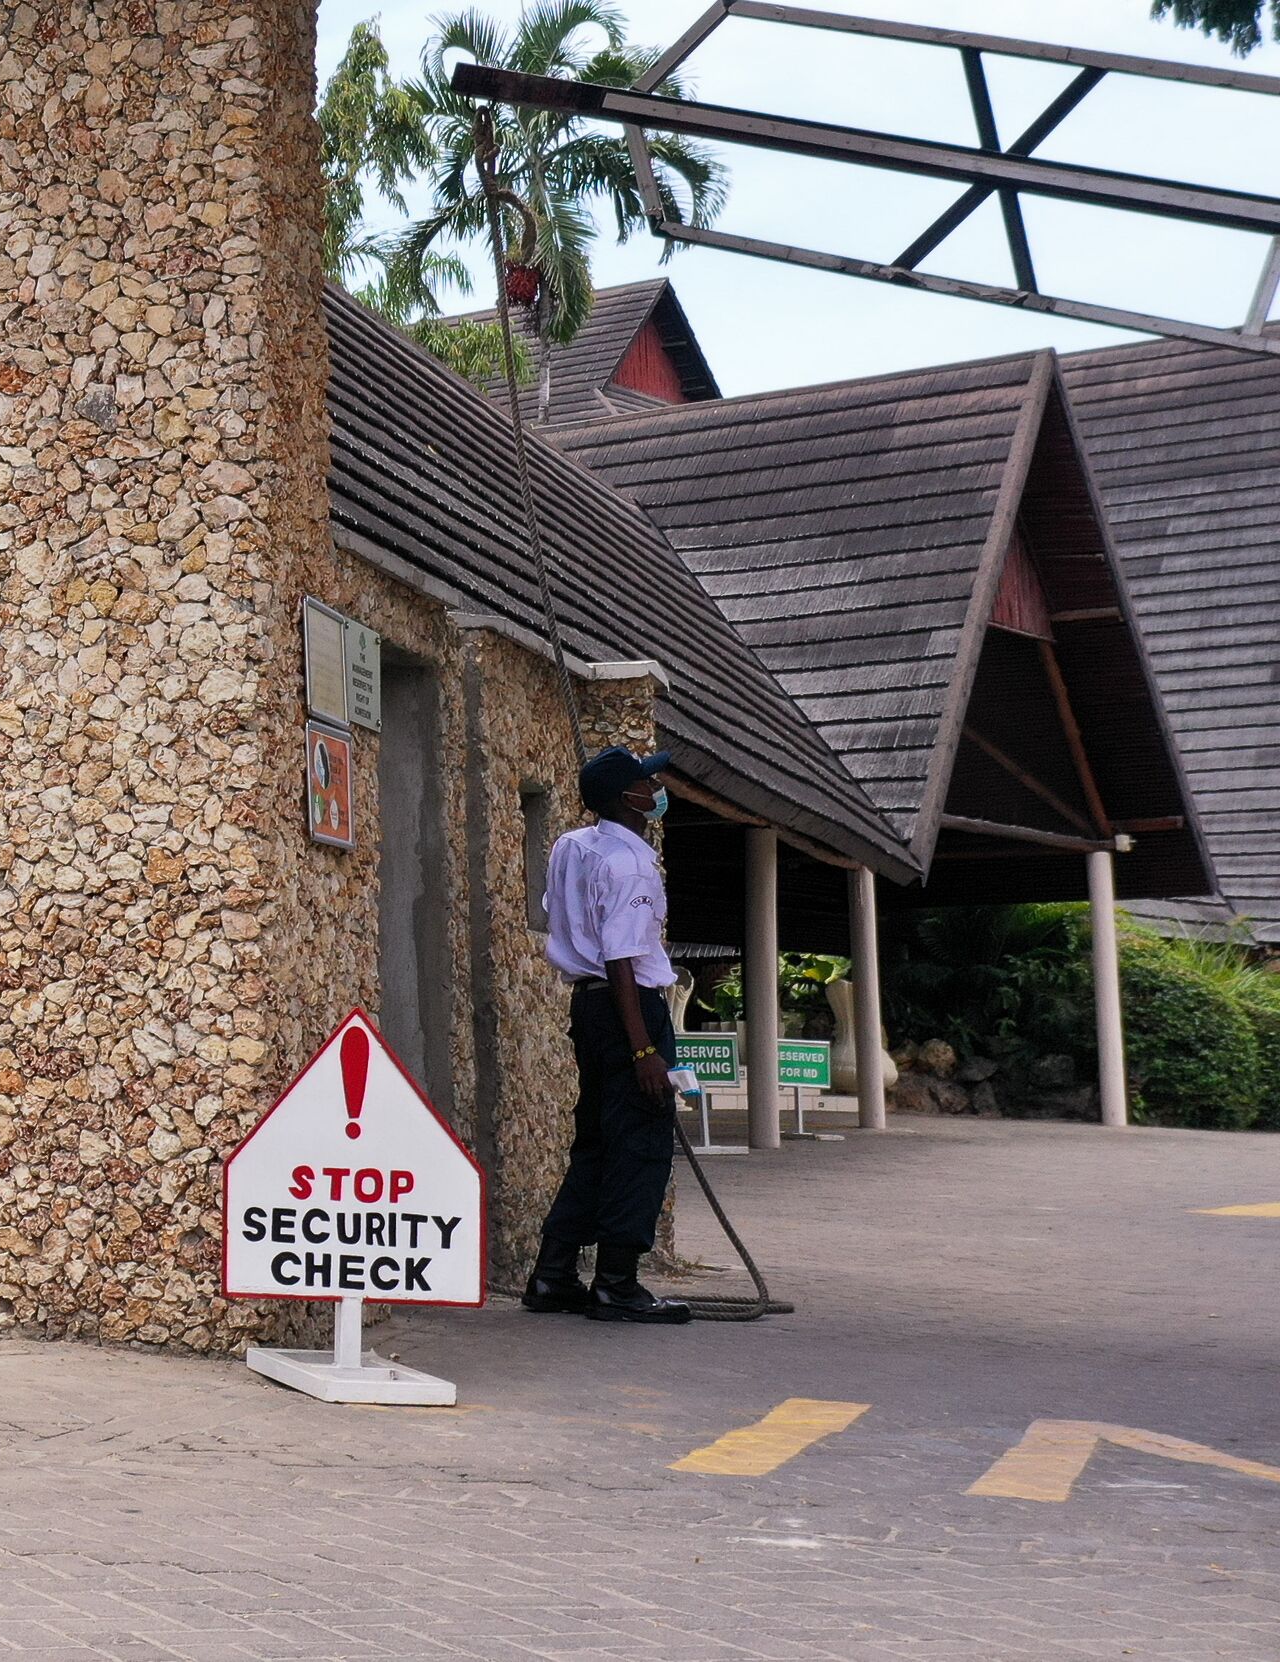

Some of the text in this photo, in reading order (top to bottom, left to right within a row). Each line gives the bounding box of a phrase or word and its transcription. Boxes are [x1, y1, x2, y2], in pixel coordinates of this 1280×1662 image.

[675, 1046, 730, 1058] ESERVED
[779, 1051, 825, 1064] ESERVED
[780, 1067, 800, 1078] FOR
[802, 1068, 818, 1079] MD
[288, 1165, 415, 1204] STOP
[242, 1207, 462, 1250] SECURITY
[270, 1252, 432, 1291] CHECK
